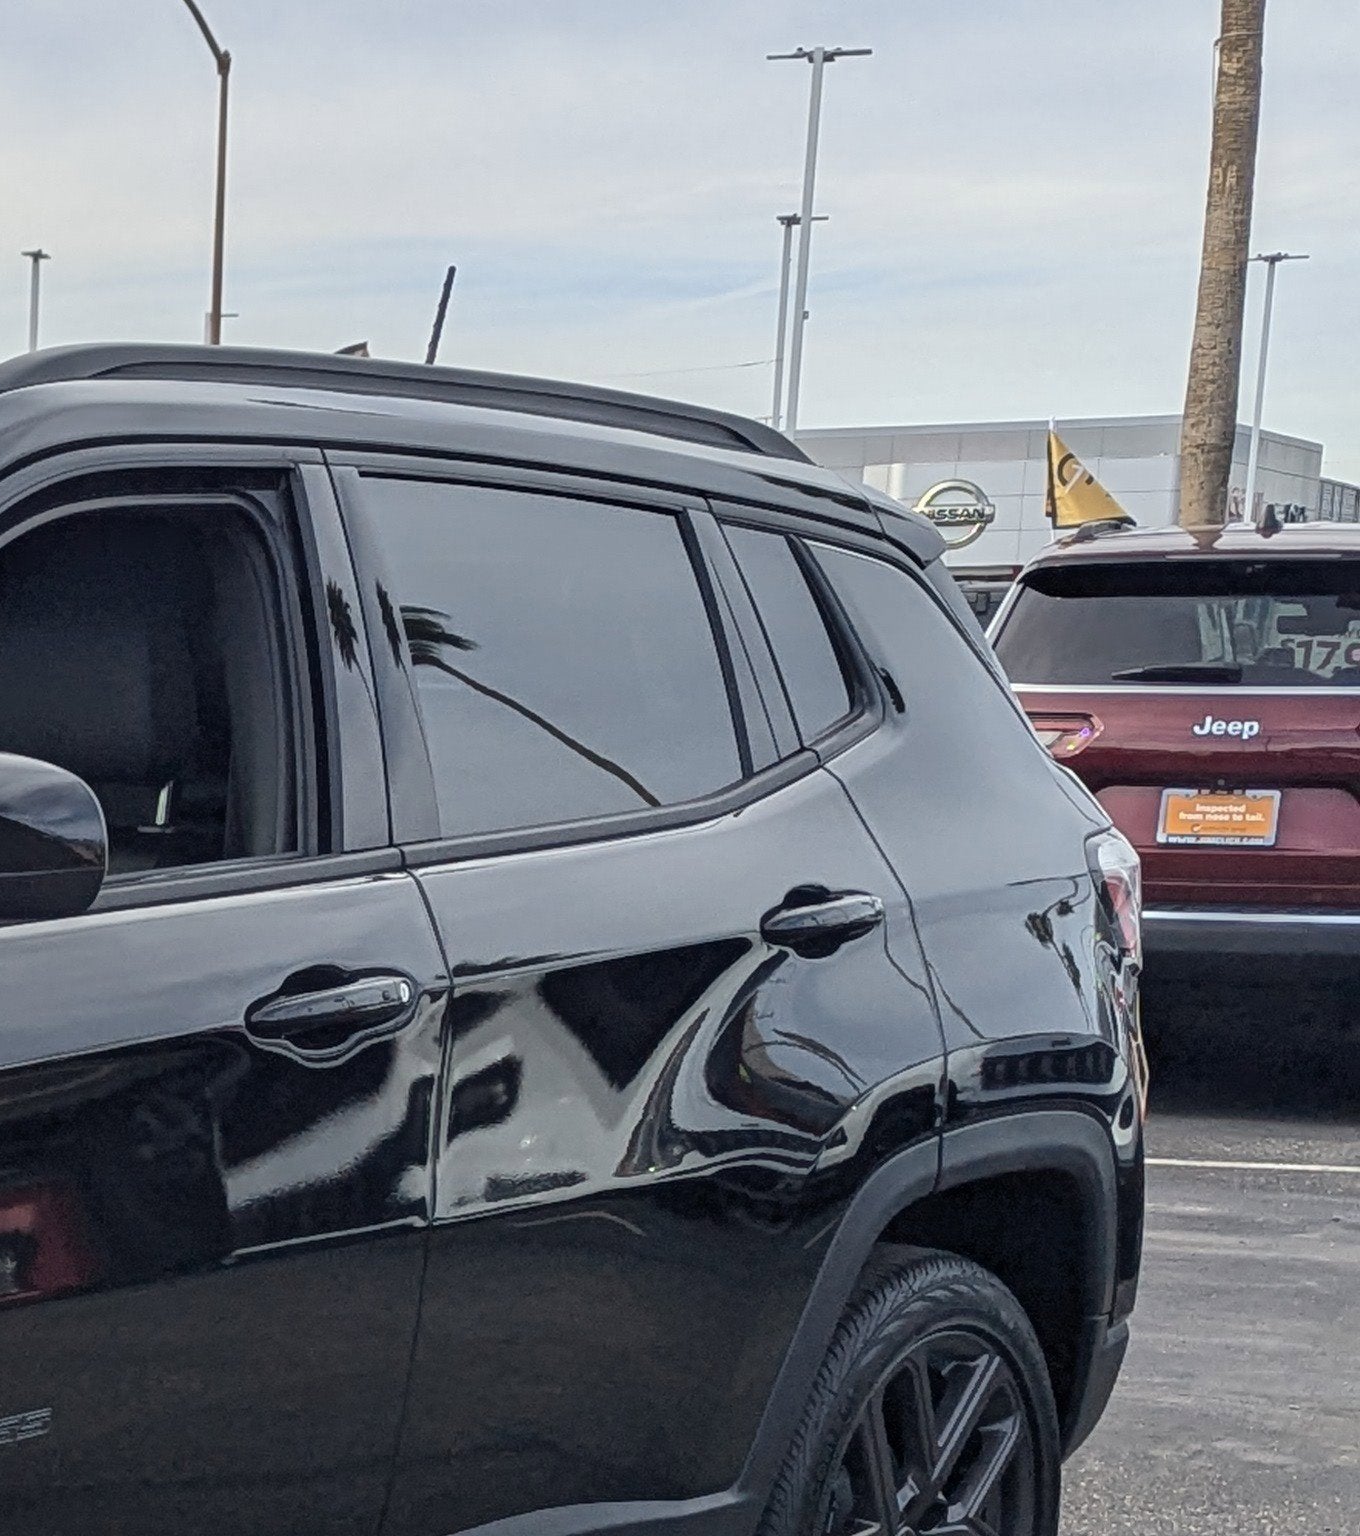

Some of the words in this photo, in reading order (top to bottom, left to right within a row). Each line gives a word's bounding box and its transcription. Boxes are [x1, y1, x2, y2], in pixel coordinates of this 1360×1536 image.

[1193, 715, 1259, 740] Jeep
[1195, 803, 1246, 813] Inspected
[1179, 811, 1203, 820] from
[1205, 813, 1231, 821] nose
[1232, 813, 1244, 821] to
